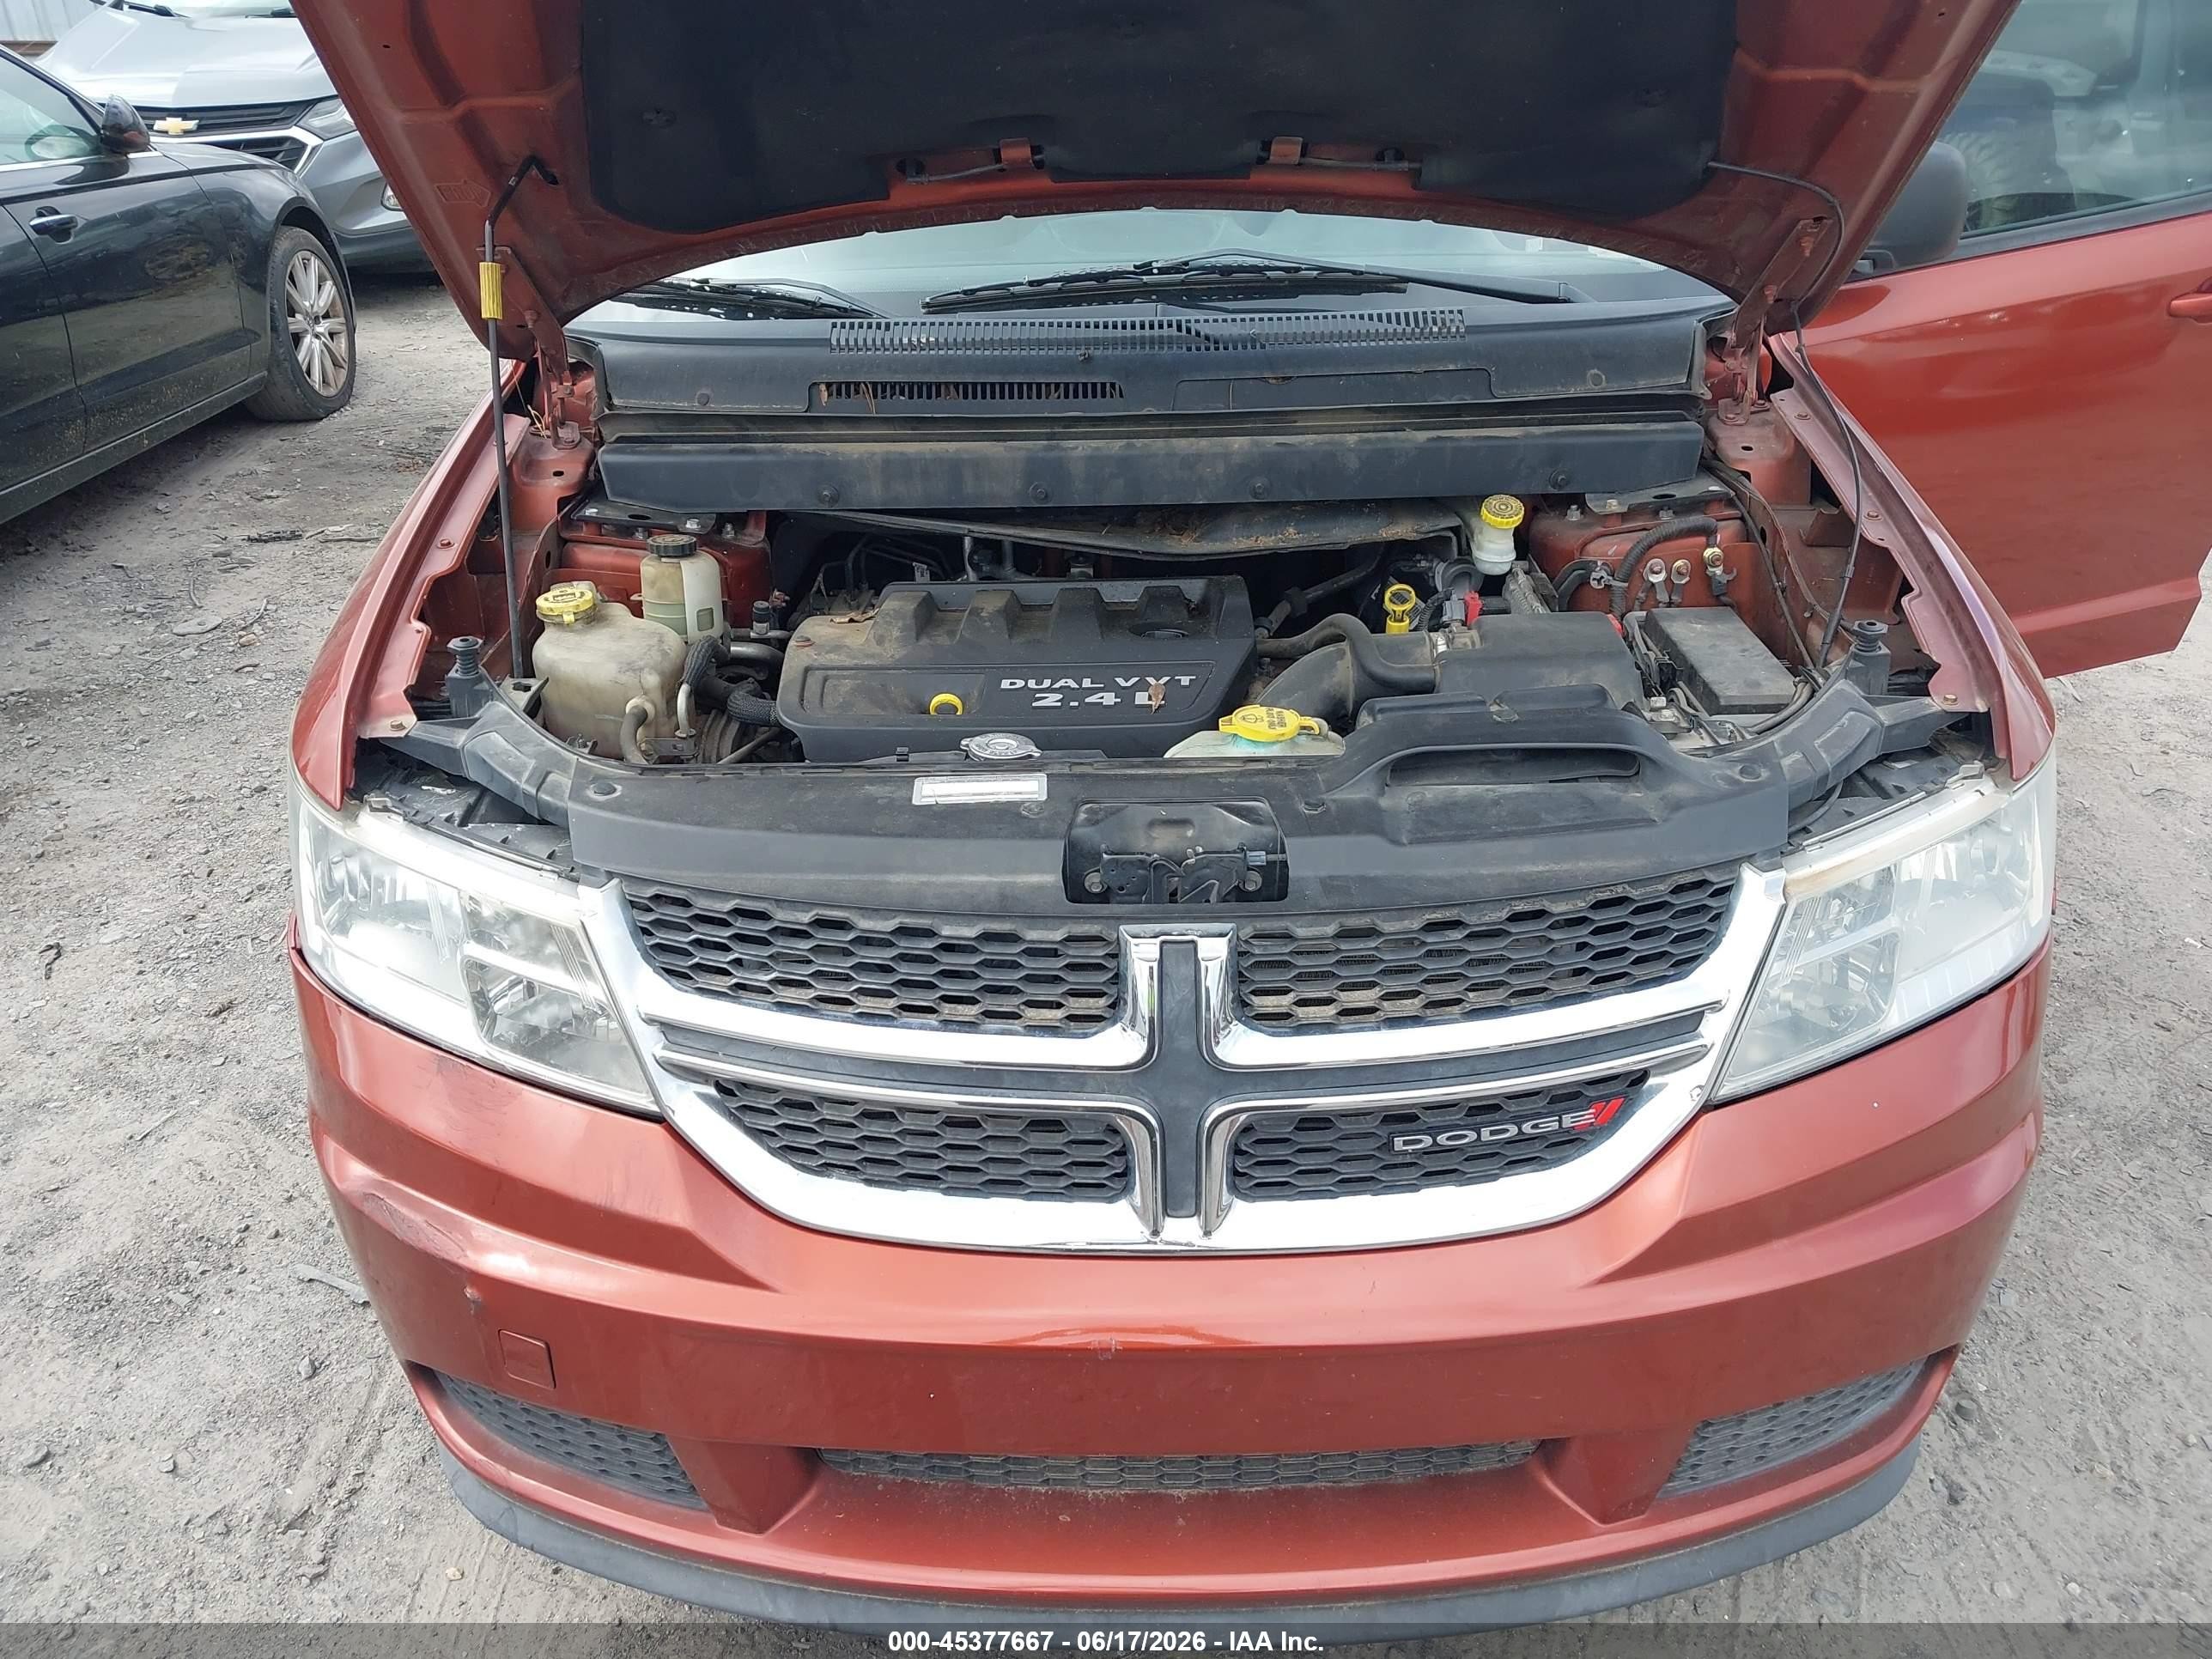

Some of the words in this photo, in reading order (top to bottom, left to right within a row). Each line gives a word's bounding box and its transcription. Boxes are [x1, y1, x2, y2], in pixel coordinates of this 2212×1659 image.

[1000, 678, 1104, 689] DUAL
[1115, 676, 1197, 687] VVT
[1031, 692, 1121, 707] 2.4
[1133, 691, 1165, 706] L
[1394, 1109, 1596, 1152] DODGE
